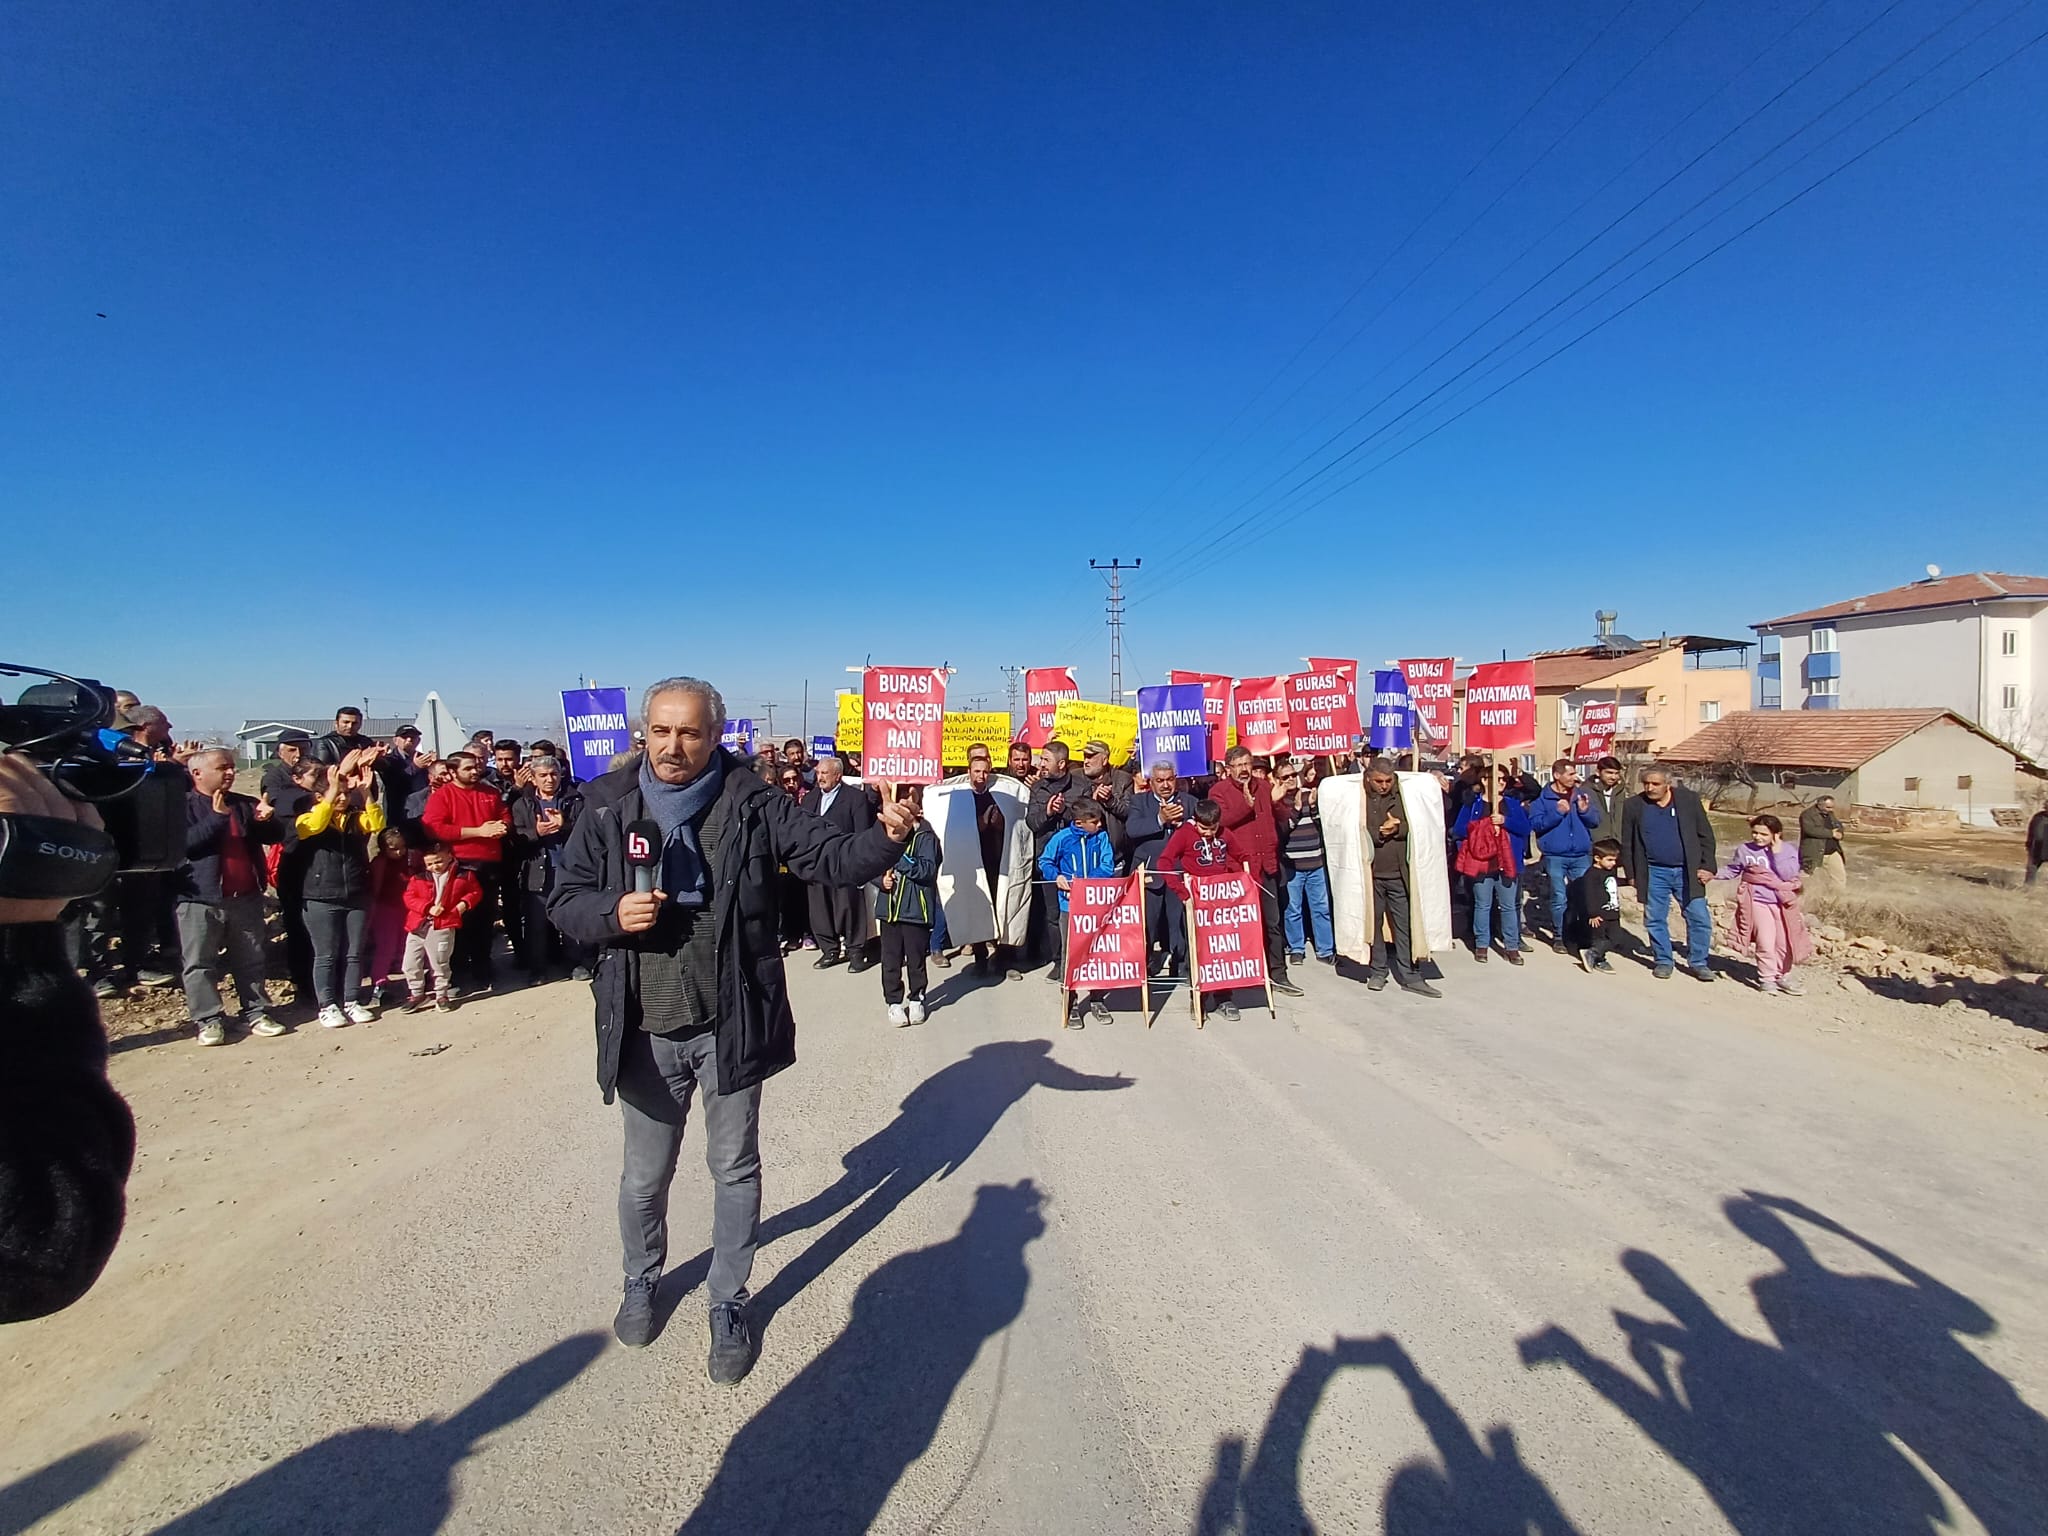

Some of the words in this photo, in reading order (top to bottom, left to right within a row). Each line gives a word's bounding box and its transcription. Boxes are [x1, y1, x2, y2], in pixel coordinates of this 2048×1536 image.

[879, 674, 932, 693] BURASI
[1295, 674, 1336, 692] BURASI
[1288, 696, 1309, 713] YOL
[1310, 694, 1346, 713] GEÇEN
[1468, 685, 1532, 704] DAYATMAYA
[867, 701, 894, 721] YOL
[895, 703, 942, 727] GEÇEN
[1238, 695, 1283, 716] KEYFİYETE
[568, 713, 626, 733] DAYATMAYA
[1141, 709, 1202, 729] DAYATMAYA
[1246, 719, 1277, 736] HAYIR!
[1306, 716, 1332, 731] HANI
[1480, 709, 1517, 726] HAYIR!
[584, 739, 615, 756] HAYIR!
[887, 727, 921, 749] HANI
[1155, 734, 1190, 753] HAYIR!
[1295, 732, 1347, 750] DEĞİLDİR!
[868, 753, 938, 777] DEĞİLDİR!
[38, 841, 102, 864] SONY
[1200, 879, 1245, 901] BURASI
[1073, 914, 1098, 934] YOL
[1101, 905, 1140, 929] GÇEN
[1196, 908, 1211, 927] OL
[1213, 904, 1258, 928] GEÇEN
[1208, 932, 1241, 954] HANI
[1072, 958, 1140, 982] DEĞİLDİR!
[1199, 956, 1261, 984] DEĞİLDİR!
